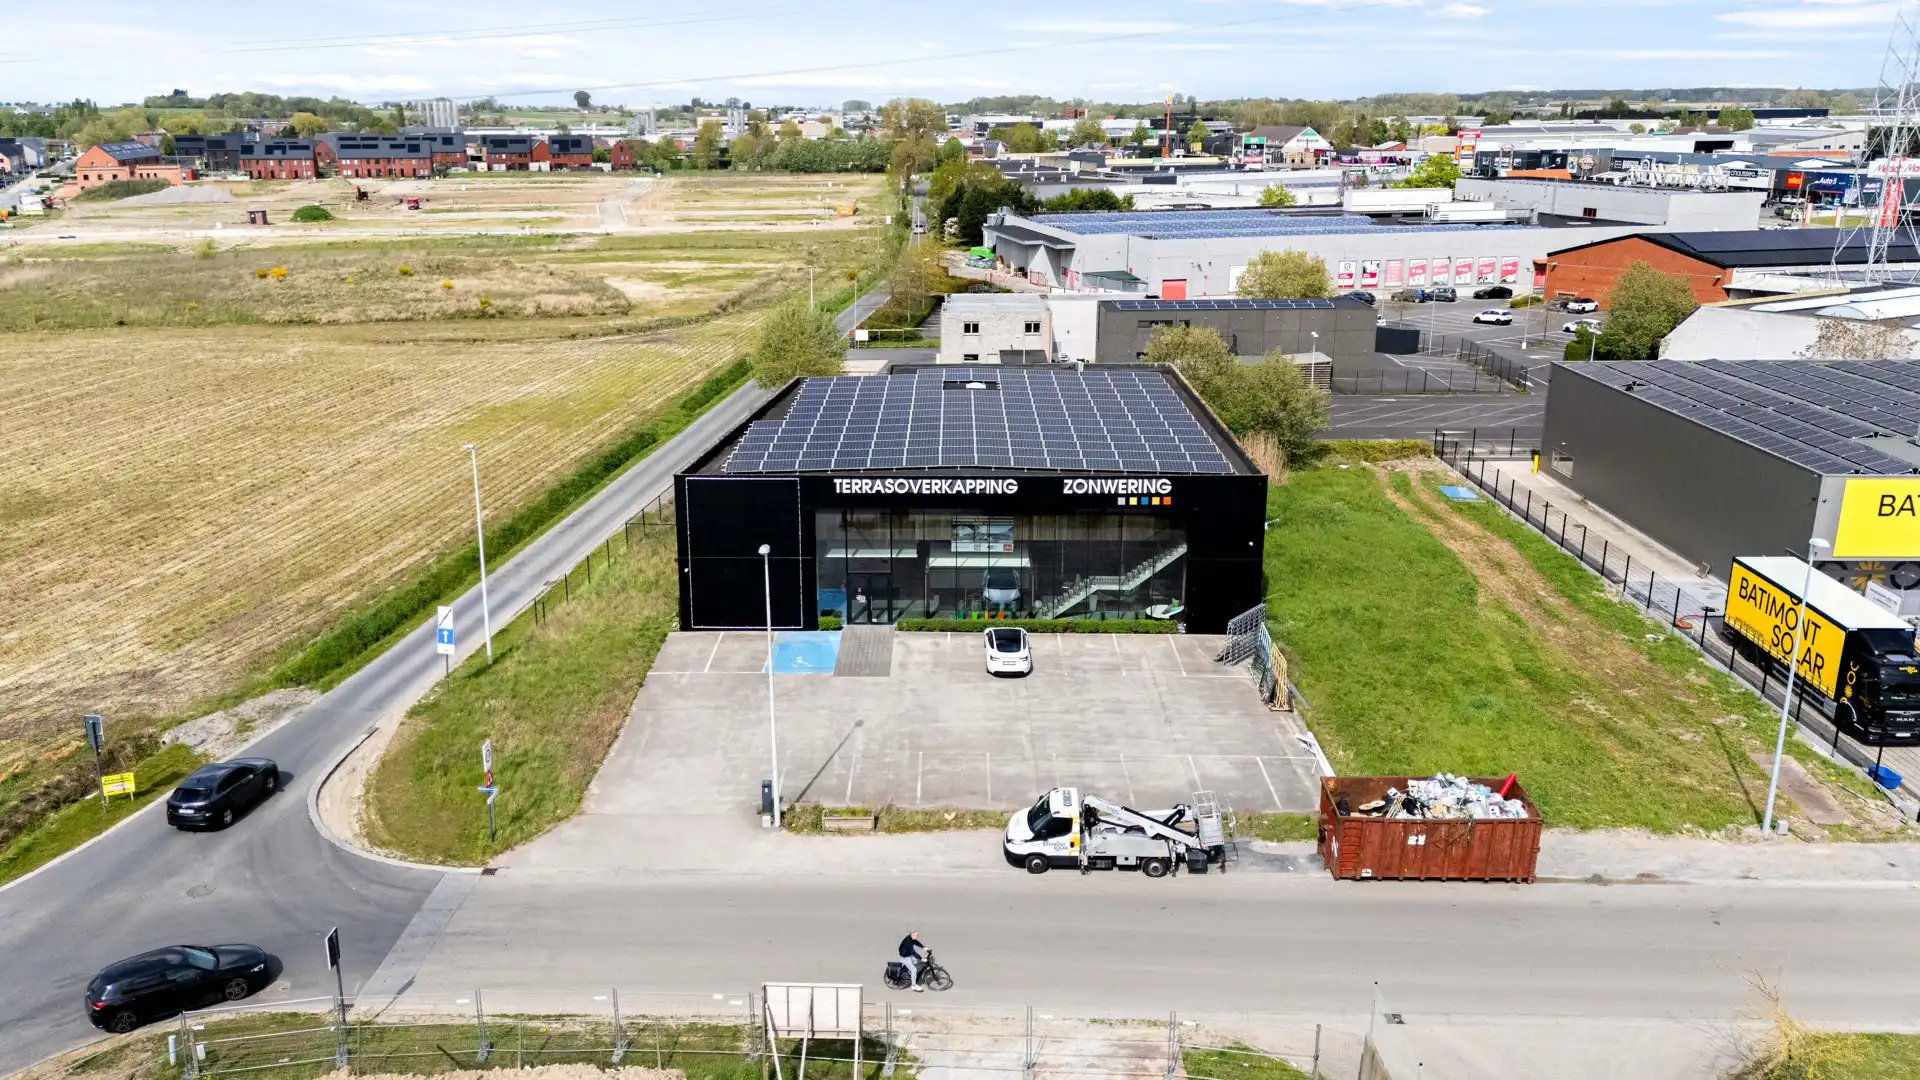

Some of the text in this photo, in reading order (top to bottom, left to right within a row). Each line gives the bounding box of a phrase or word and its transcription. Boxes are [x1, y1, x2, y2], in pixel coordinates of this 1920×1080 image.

[833, 478, 1019, 495] TERRASOVERKAPPING
[1063, 478, 1173, 495] ZONWERING
[1878, 494, 1920, 517] BA
[1738, 576, 1821, 646] BATIMONT
[1771, 624, 1825, 679] SOAR
